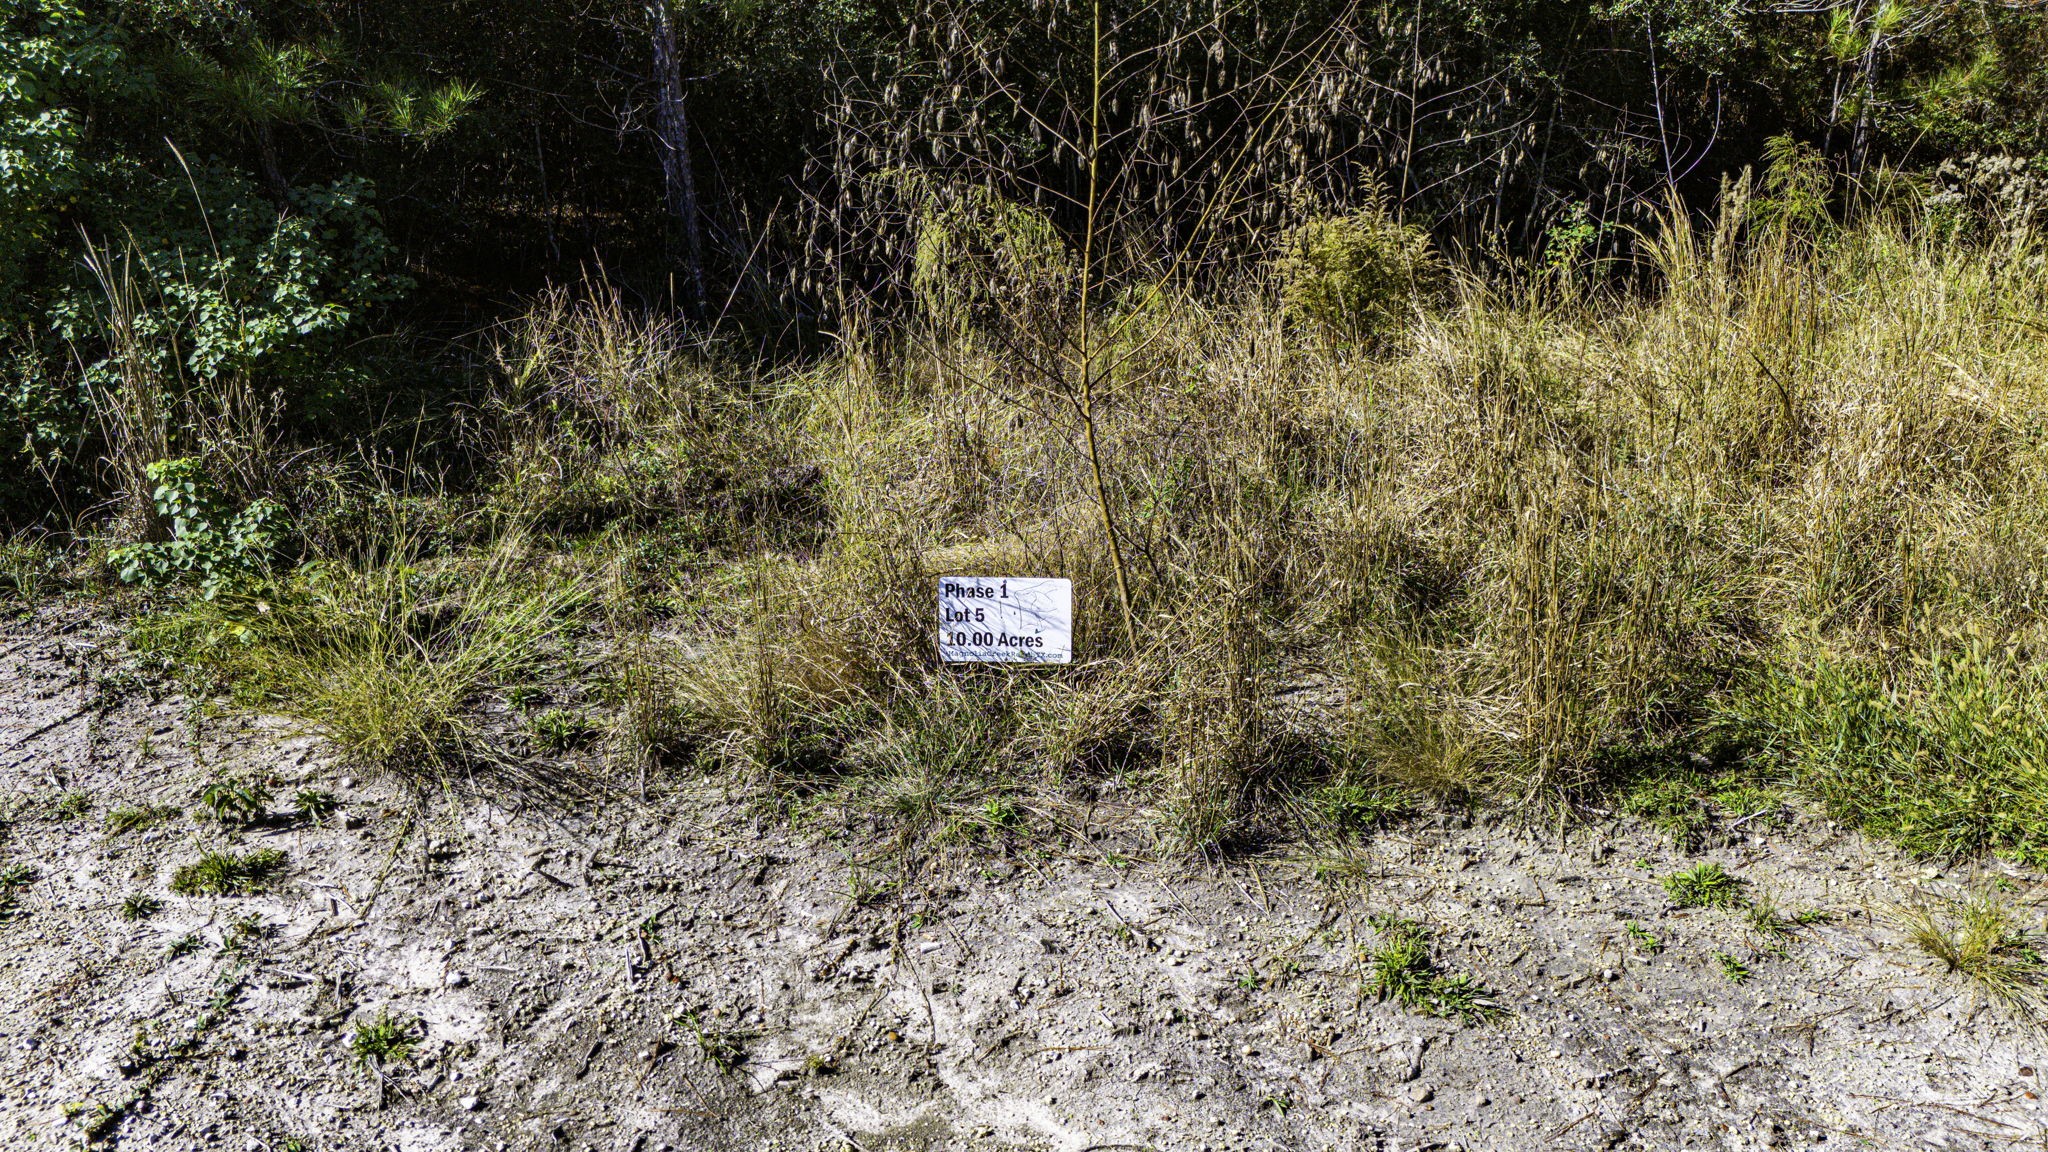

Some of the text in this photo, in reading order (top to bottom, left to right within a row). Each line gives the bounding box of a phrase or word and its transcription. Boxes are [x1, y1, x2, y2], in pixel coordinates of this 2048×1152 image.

[945, 583, 1009, 598] Phase 1
[945, 608, 985, 622] Lot 5
[946, 632, 1044, 647] 10.00 Acres
